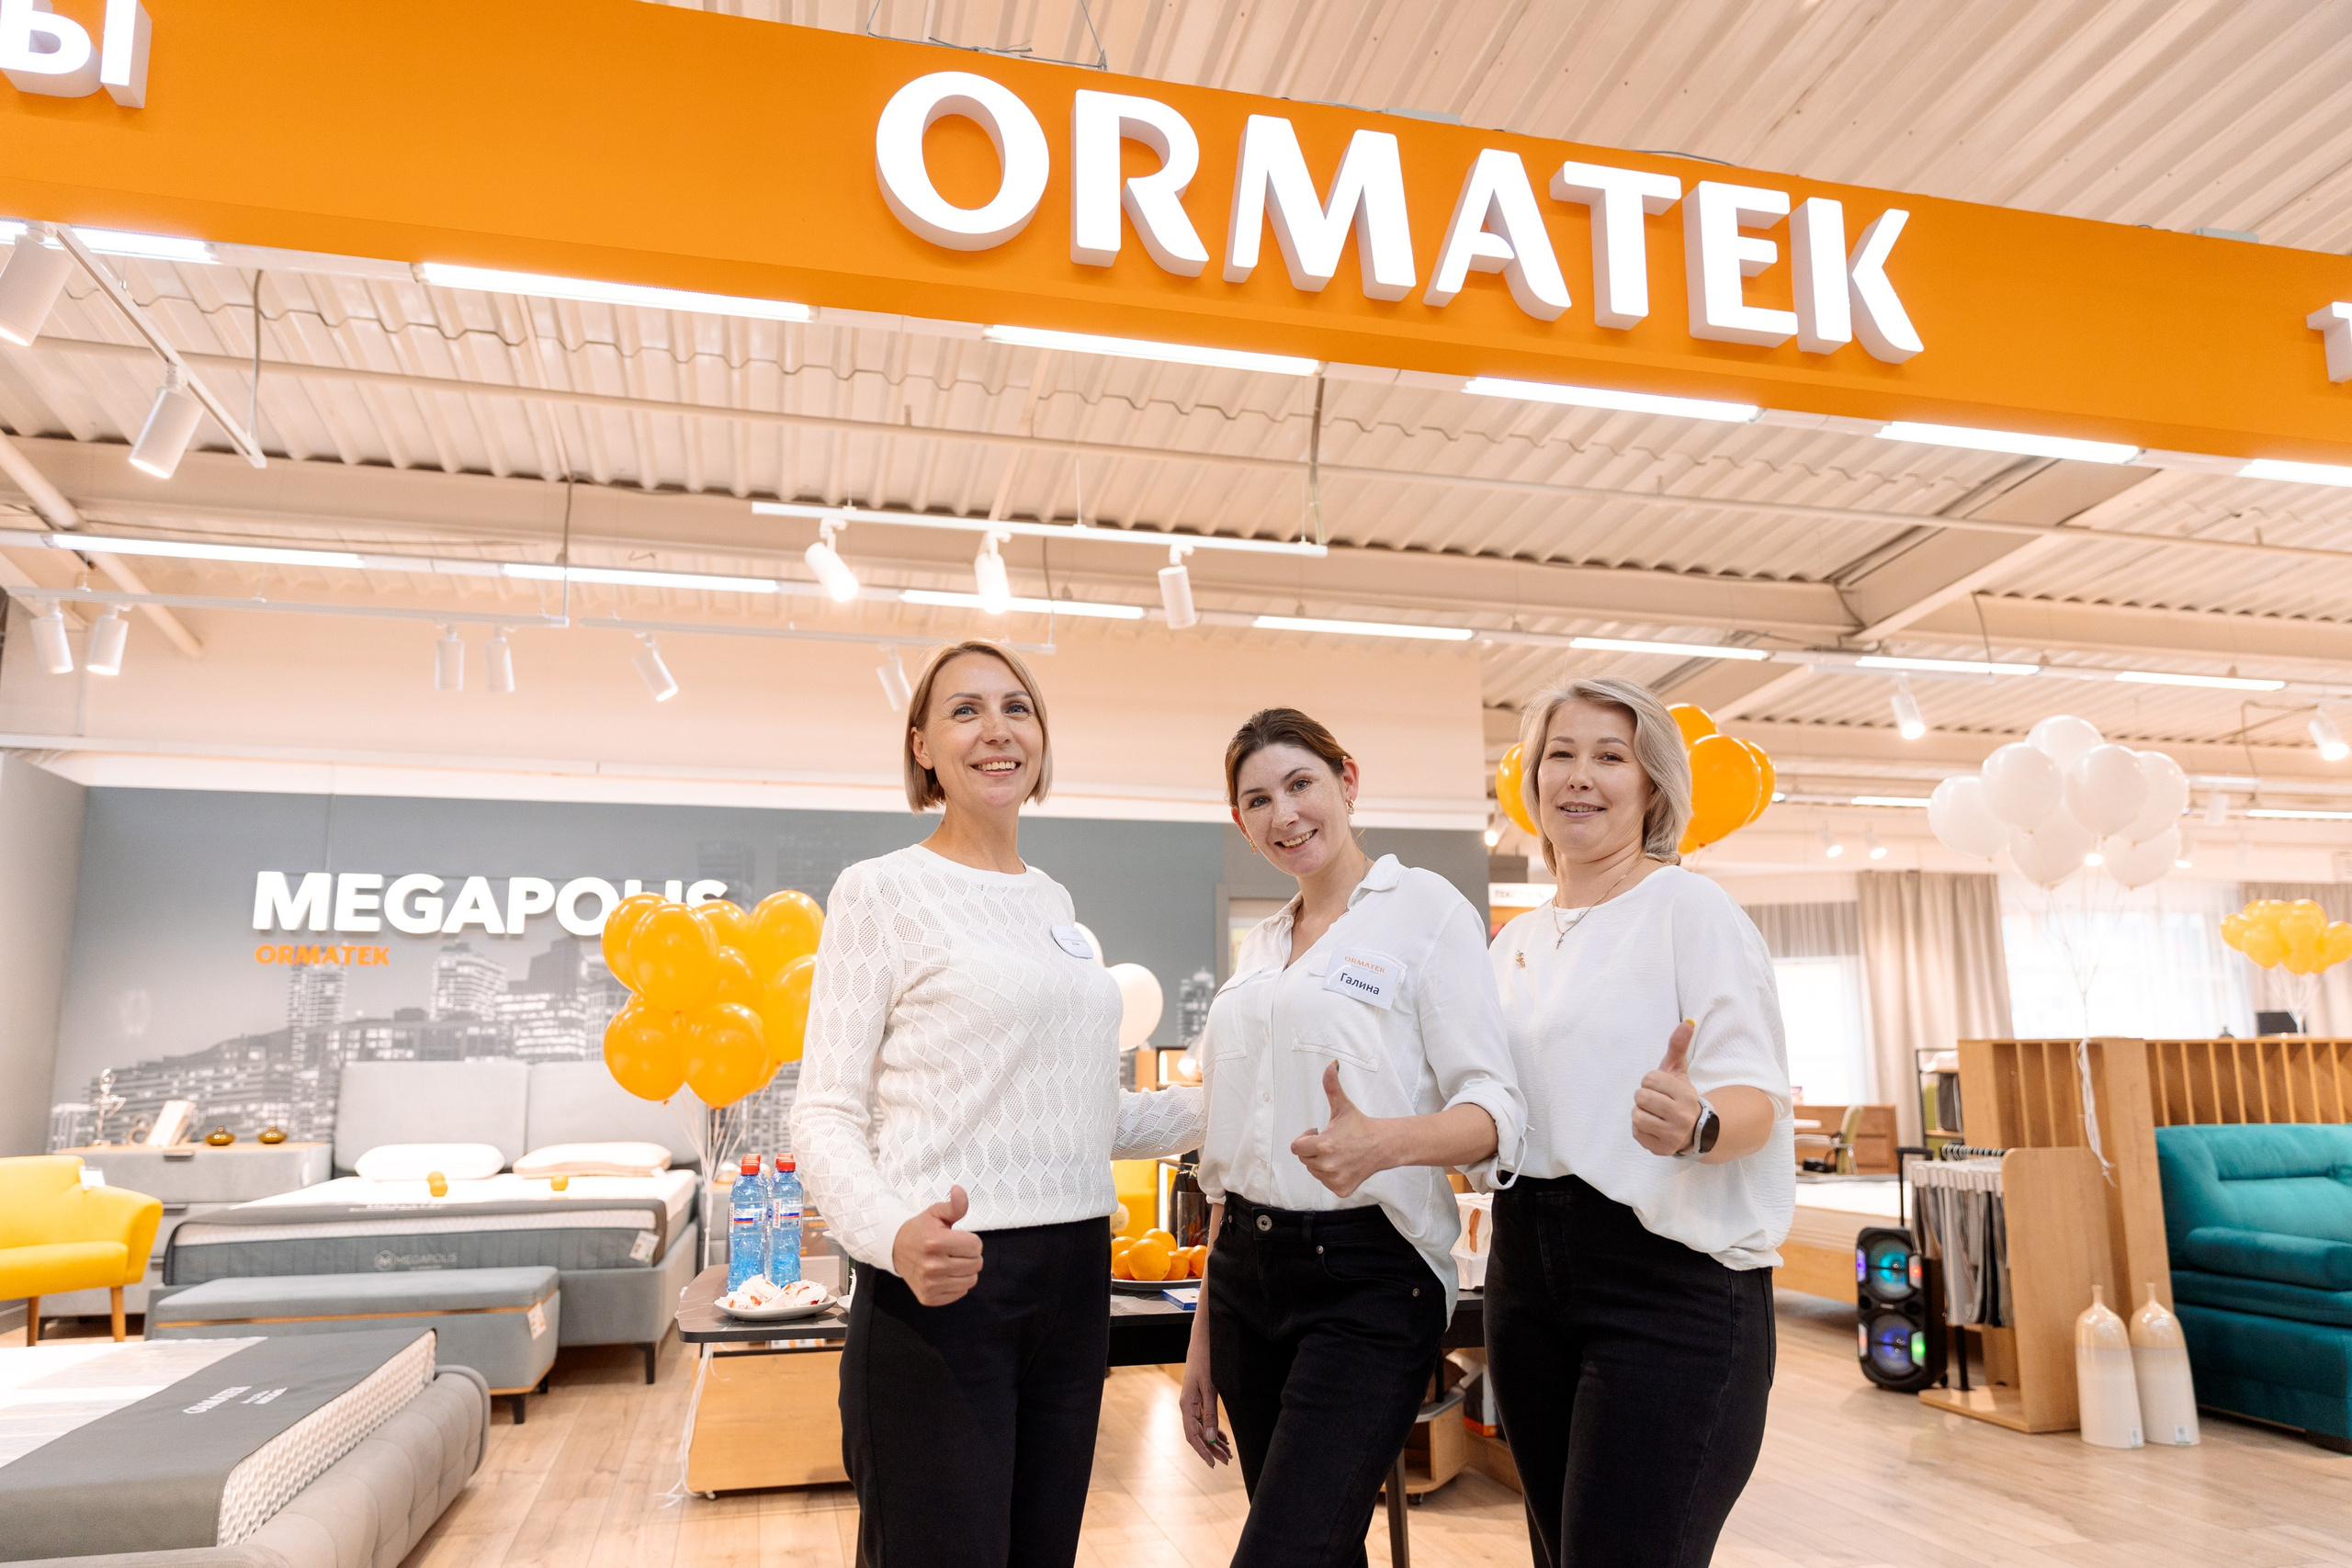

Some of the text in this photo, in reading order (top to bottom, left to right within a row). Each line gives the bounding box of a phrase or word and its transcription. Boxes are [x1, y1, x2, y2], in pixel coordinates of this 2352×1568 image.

[876, 71, 1925, 365] ORMATEK
[252, 871, 729, 937] MEGAPO
[254, 944, 390, 966] ORMATEK
[1344, 956, 1385, 974] ORMATEK
[1340, 973, 1380, 995] Галина
